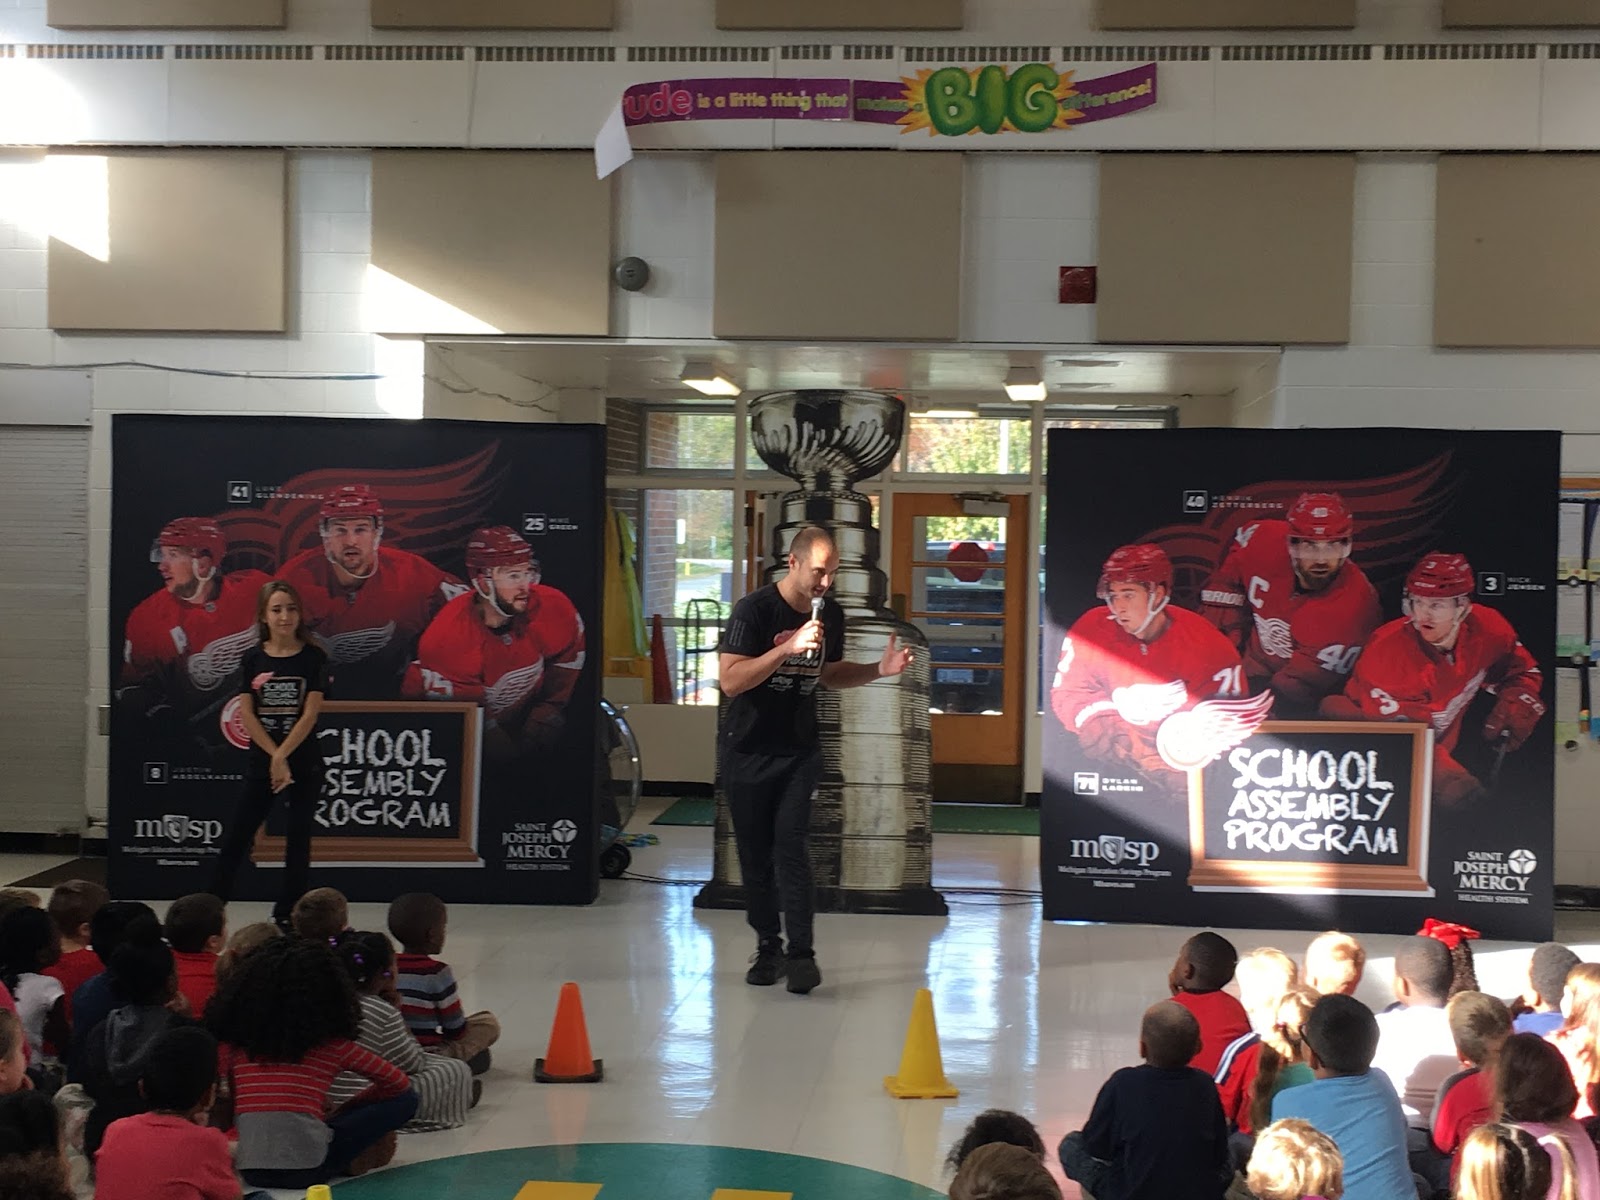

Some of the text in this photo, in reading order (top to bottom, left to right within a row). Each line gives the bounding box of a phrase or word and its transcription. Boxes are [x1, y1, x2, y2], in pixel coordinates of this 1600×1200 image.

[697, 93, 710, 108] is
[714, 95, 726, 107] a
[729, 92, 767, 108] little
[770, 92, 811, 111] thing
[814, 92, 847, 107] that
[925, 63, 1059, 136] BIG
[231, 486, 248, 498] 41
[1186, 495, 1205, 508] 40
[525, 517, 545, 530] 25
[1248, 575, 1271, 609] C
[1485, 577, 1498, 591] 3
[1316, 643, 1363, 675] 40
[1212, 664, 1242, 696] 71
[1369, 687, 1400, 715] 3
[316, 728, 447, 768] CHOOL
[321, 768, 448, 797] SEMBLY
[1228, 747, 1395, 791] SCHOOL
[314, 799, 451, 829] ROGRAM
[1227, 790, 1395, 822] ASSEMBLY
[502, 832, 552, 845] JOSEPH
[513, 822, 547, 832] SAINT
[1223, 819, 1399, 855] PROGRAM
[507, 845, 571, 859] MERCY
[1467, 851, 1503, 861] SAINT
[1453, 861, 1509, 875] JOSEPH
[1459, 874, 1531, 891] MERCY
